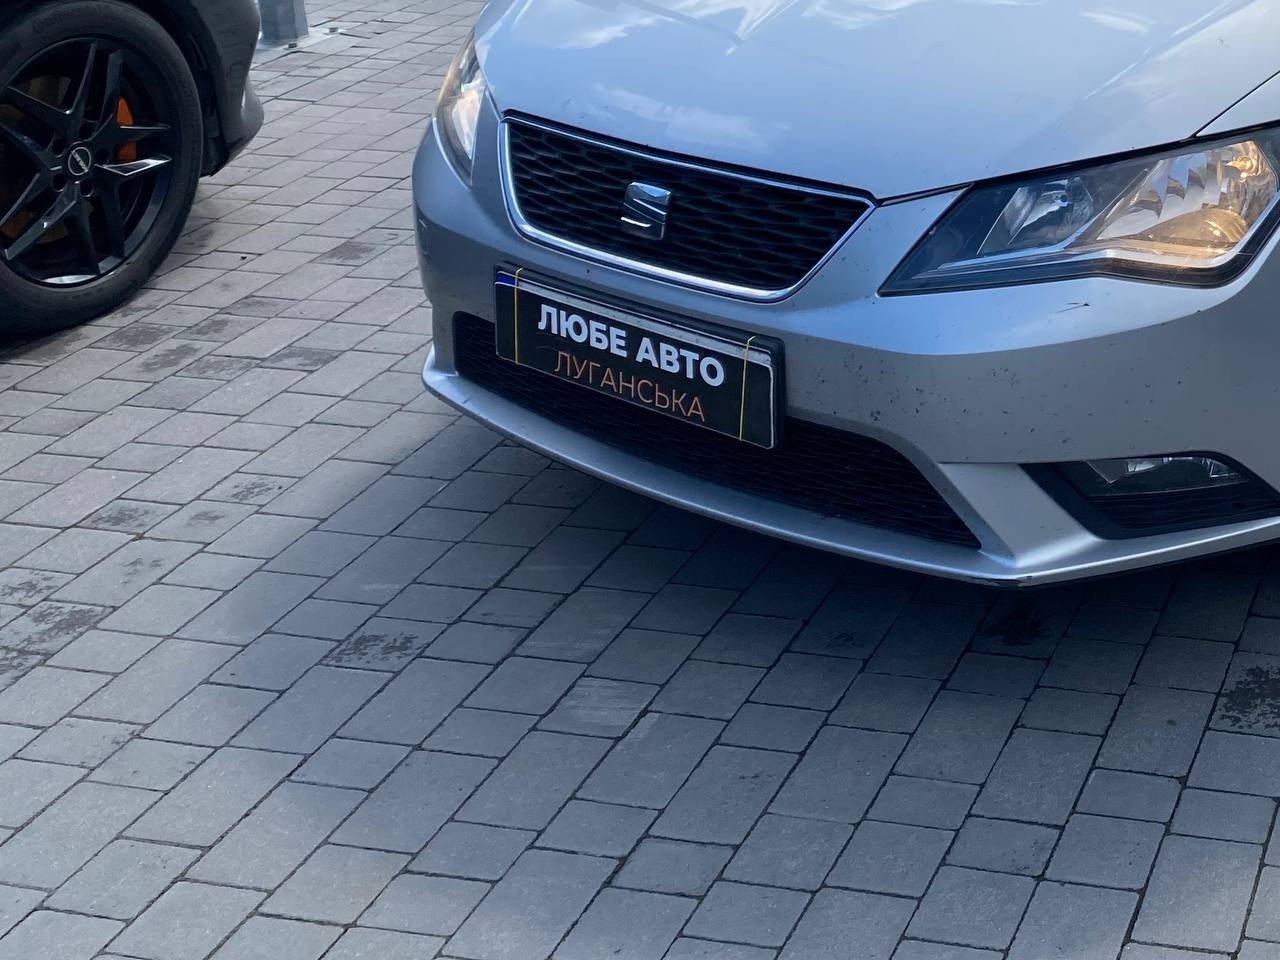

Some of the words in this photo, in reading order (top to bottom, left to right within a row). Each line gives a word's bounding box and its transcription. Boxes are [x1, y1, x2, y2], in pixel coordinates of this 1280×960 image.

[537, 303, 628, 359] ЛЮБЕ
[634, 336, 726, 388] АВТО
[553, 350, 706, 423] ЛУГАНСЬКА
